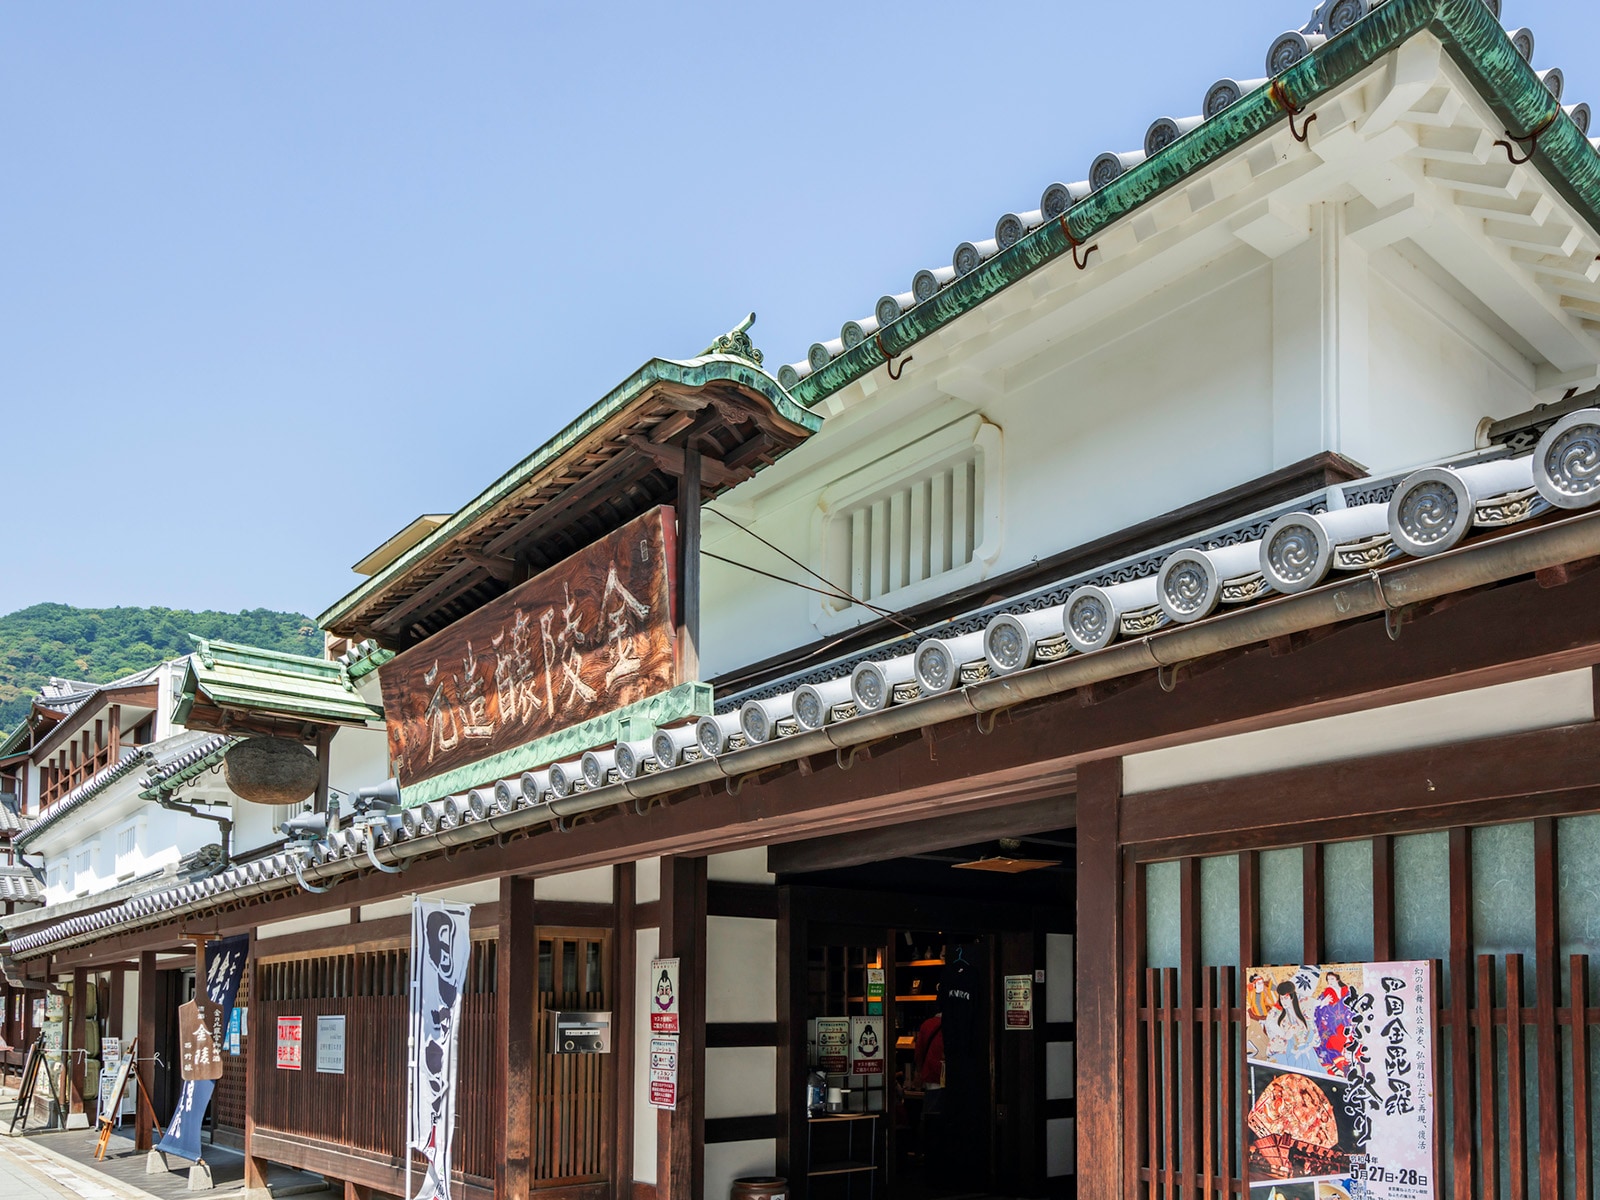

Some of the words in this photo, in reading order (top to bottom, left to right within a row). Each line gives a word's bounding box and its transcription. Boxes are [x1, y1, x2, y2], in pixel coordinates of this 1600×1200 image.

[192, 1023, 213, 1065] 金陵
[1343, 986, 1383, 1145] ねぷた祭り
[1381, 976, 1415, 1116] 四国金毘羅
[1350, 1153, 1379, 1164] 令和4年
